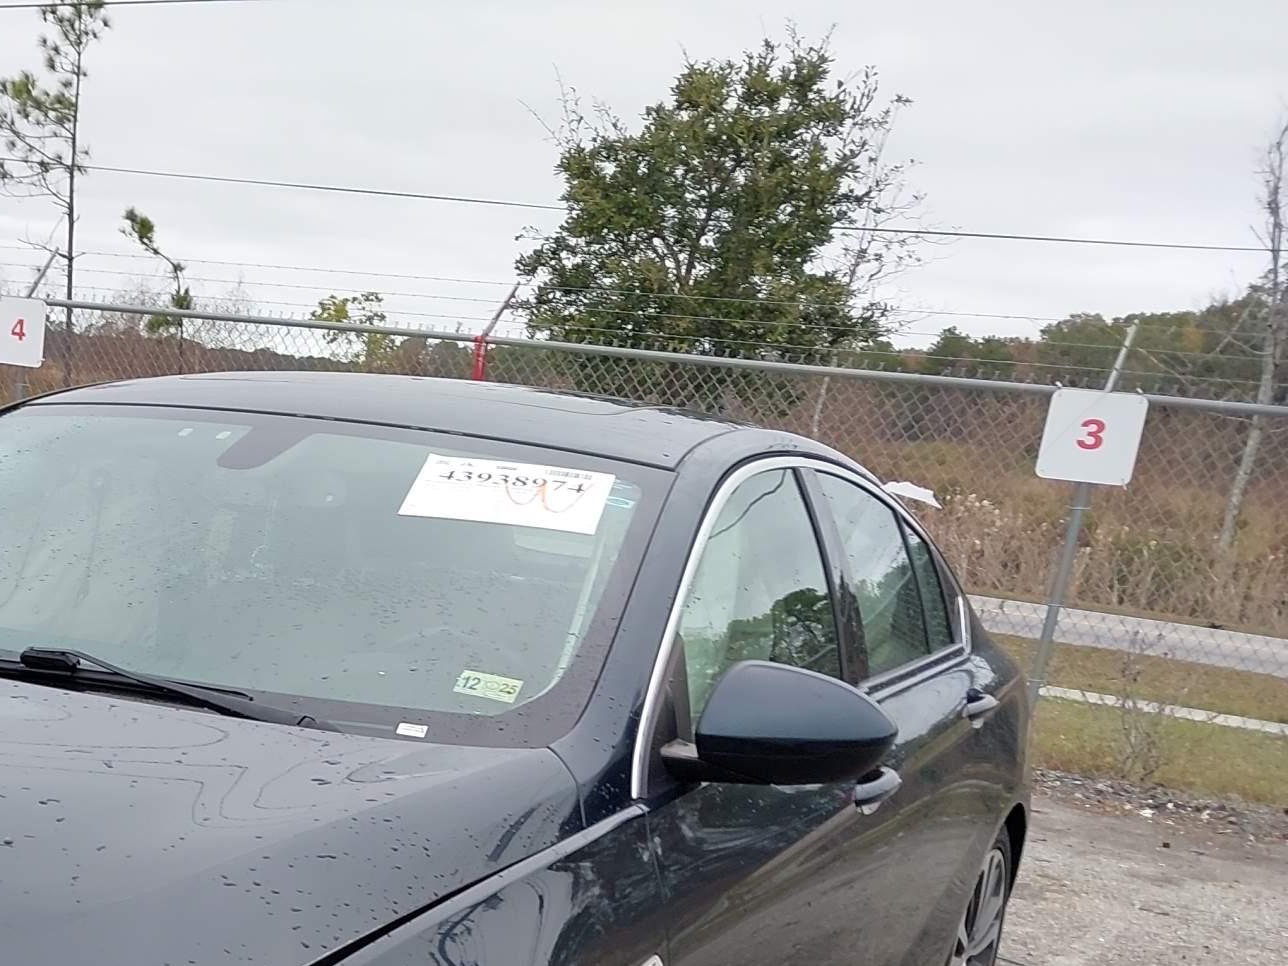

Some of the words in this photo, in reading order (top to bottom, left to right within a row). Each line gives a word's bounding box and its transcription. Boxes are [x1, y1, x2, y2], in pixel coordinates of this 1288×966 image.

[11, 318, 26, 341] 4
[1075, 418, 1106, 450] 3
[438, 470, 585, 494] 43938974
[463, 676, 480, 690] 12
